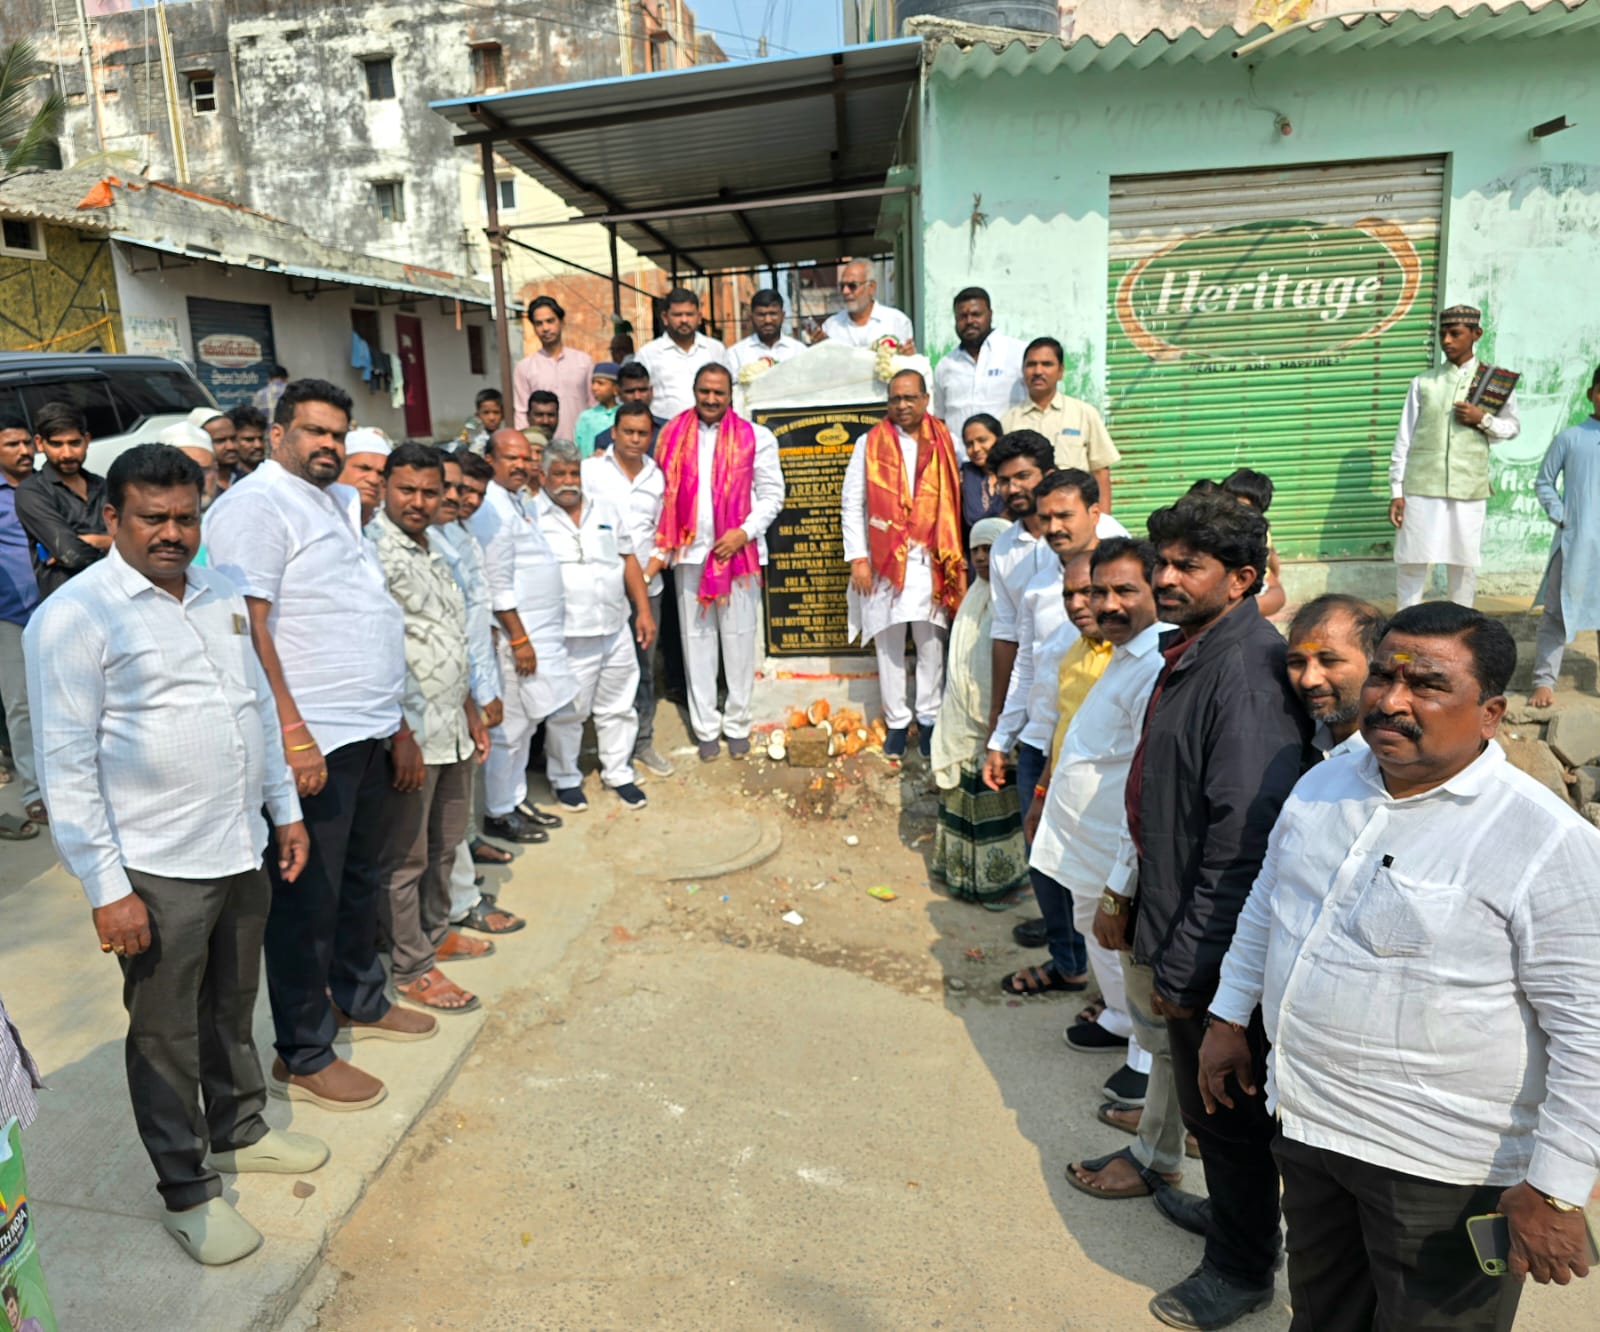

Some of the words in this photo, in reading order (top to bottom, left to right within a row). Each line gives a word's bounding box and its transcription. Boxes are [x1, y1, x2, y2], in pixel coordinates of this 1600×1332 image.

[1152, 267, 1381, 321] Heritage
[789, 482, 843, 497] AREKAPU
[10, 1208, 28, 1238] INDIA
